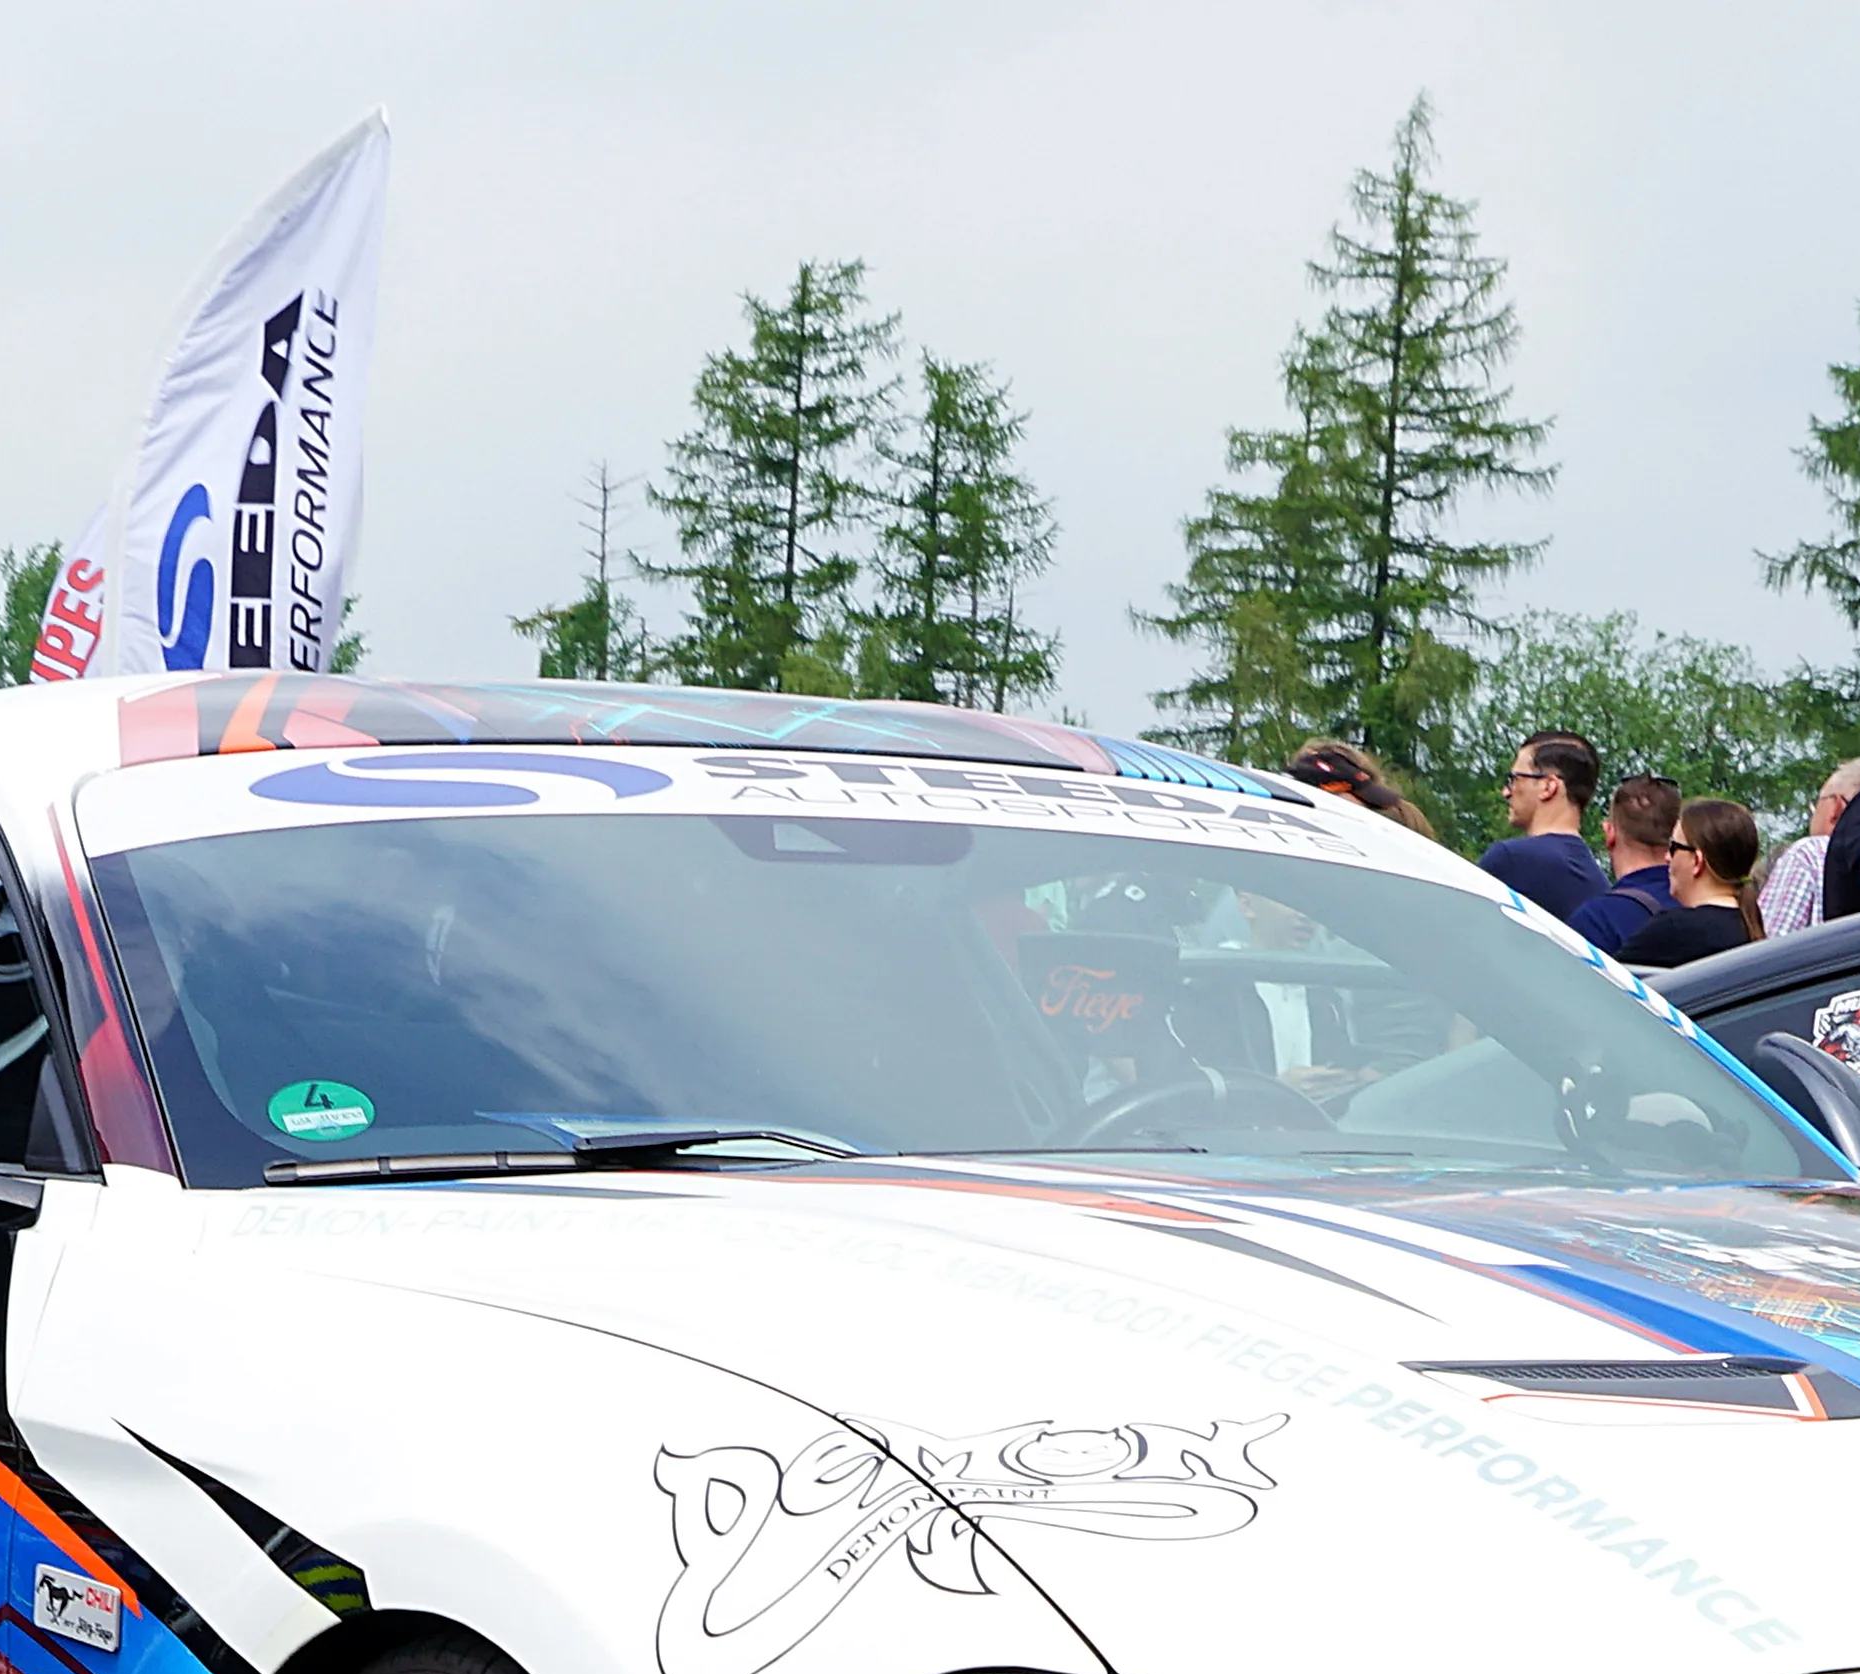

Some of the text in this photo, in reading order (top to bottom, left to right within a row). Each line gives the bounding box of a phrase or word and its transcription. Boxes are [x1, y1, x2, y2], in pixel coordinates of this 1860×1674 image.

[703, 755, 1339, 836] STEEDA
[730, 783, 1368, 858] AUTOSPORTS
[1040, 965, 1145, 1033] Fiege
[303, 1083, 336, 1110] 4
[1182, 1322, 1345, 1399] FIEGE
[1339, 1379, 1800, 1656] PERFORMANCE
[827, 1484, 1057, 1587] DEMON PAINT
